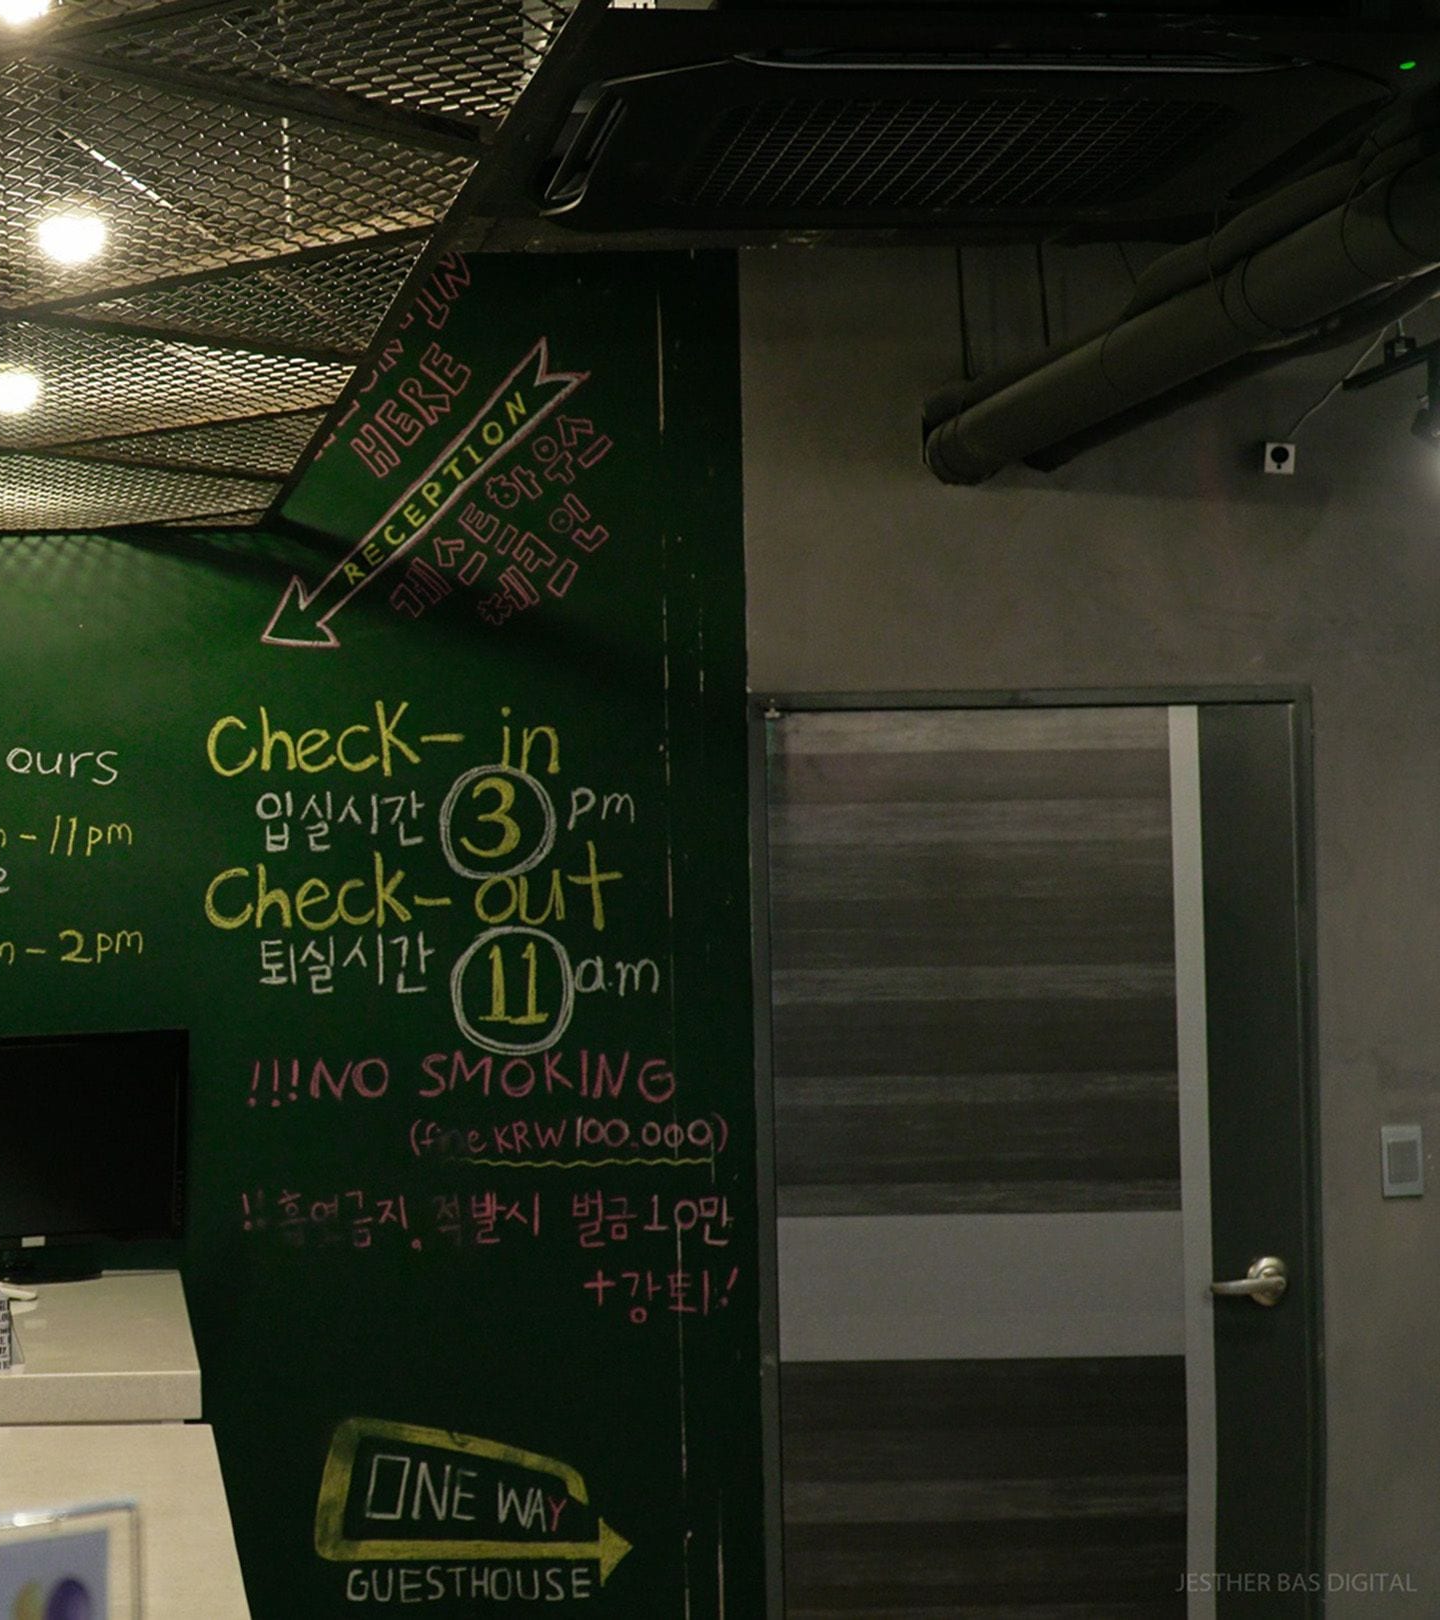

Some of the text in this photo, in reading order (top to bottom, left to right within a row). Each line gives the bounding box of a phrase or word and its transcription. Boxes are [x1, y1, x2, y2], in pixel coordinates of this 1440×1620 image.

[350, 342, 472, 478] HERE
[344, 391, 528, 584] RECEPTION
[255, 777, 636, 859] 입실시간 3 pm
[259, 930, 435, 995] 퇴실시간
[478, 941, 549, 1026] 11
[419, 1049, 678, 1104] SMOKING
[365, 1453, 567, 1532] ONE WAY
[346, 1565, 592, 1603] GUESTHOUSE
